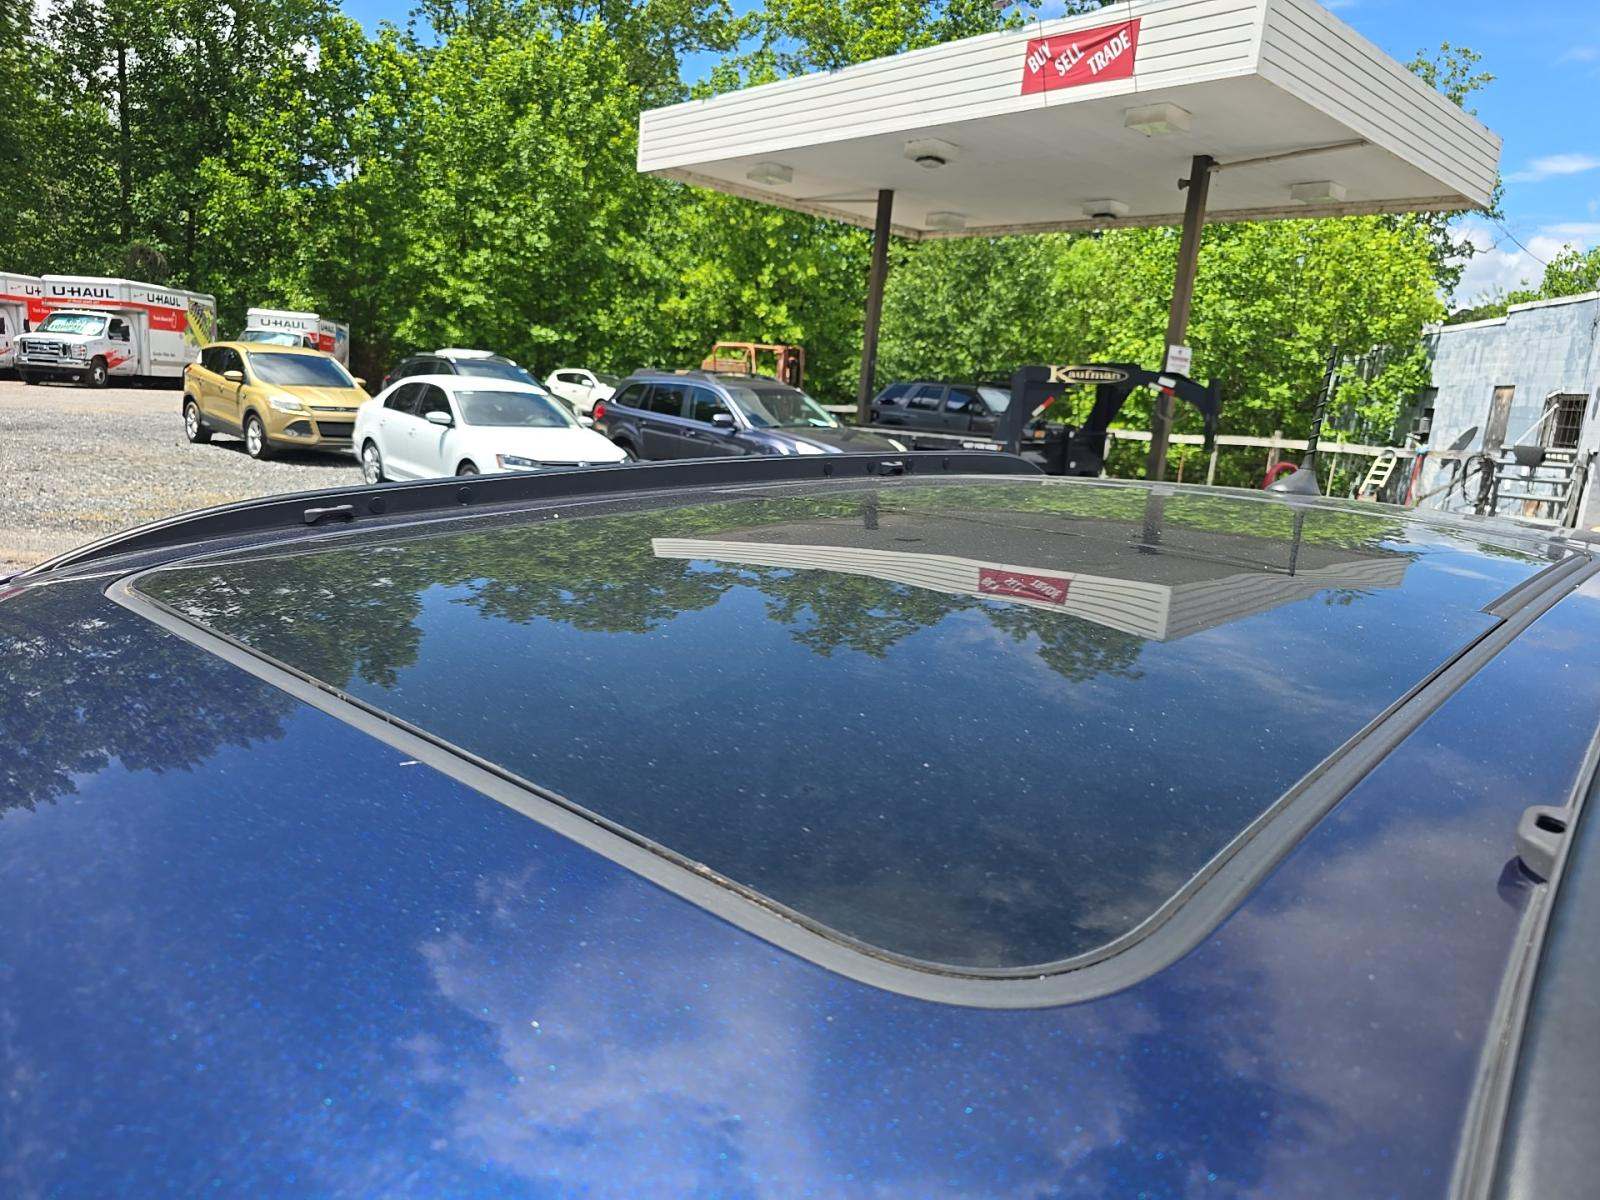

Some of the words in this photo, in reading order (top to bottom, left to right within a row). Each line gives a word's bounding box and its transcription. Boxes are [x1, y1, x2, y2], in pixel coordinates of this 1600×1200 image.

[1027, 41, 1052, 74] BUY
[1054, 43, 1085, 77] SELL
[1087, 30, 1131, 75] TRADE
[53, 286, 114, 298] U-HAUL
[147, 293, 181, 307] U-HAUL
[261, 319, 308, 330] U-HAUL
[1047, 365, 1122, 384] Kaufman
